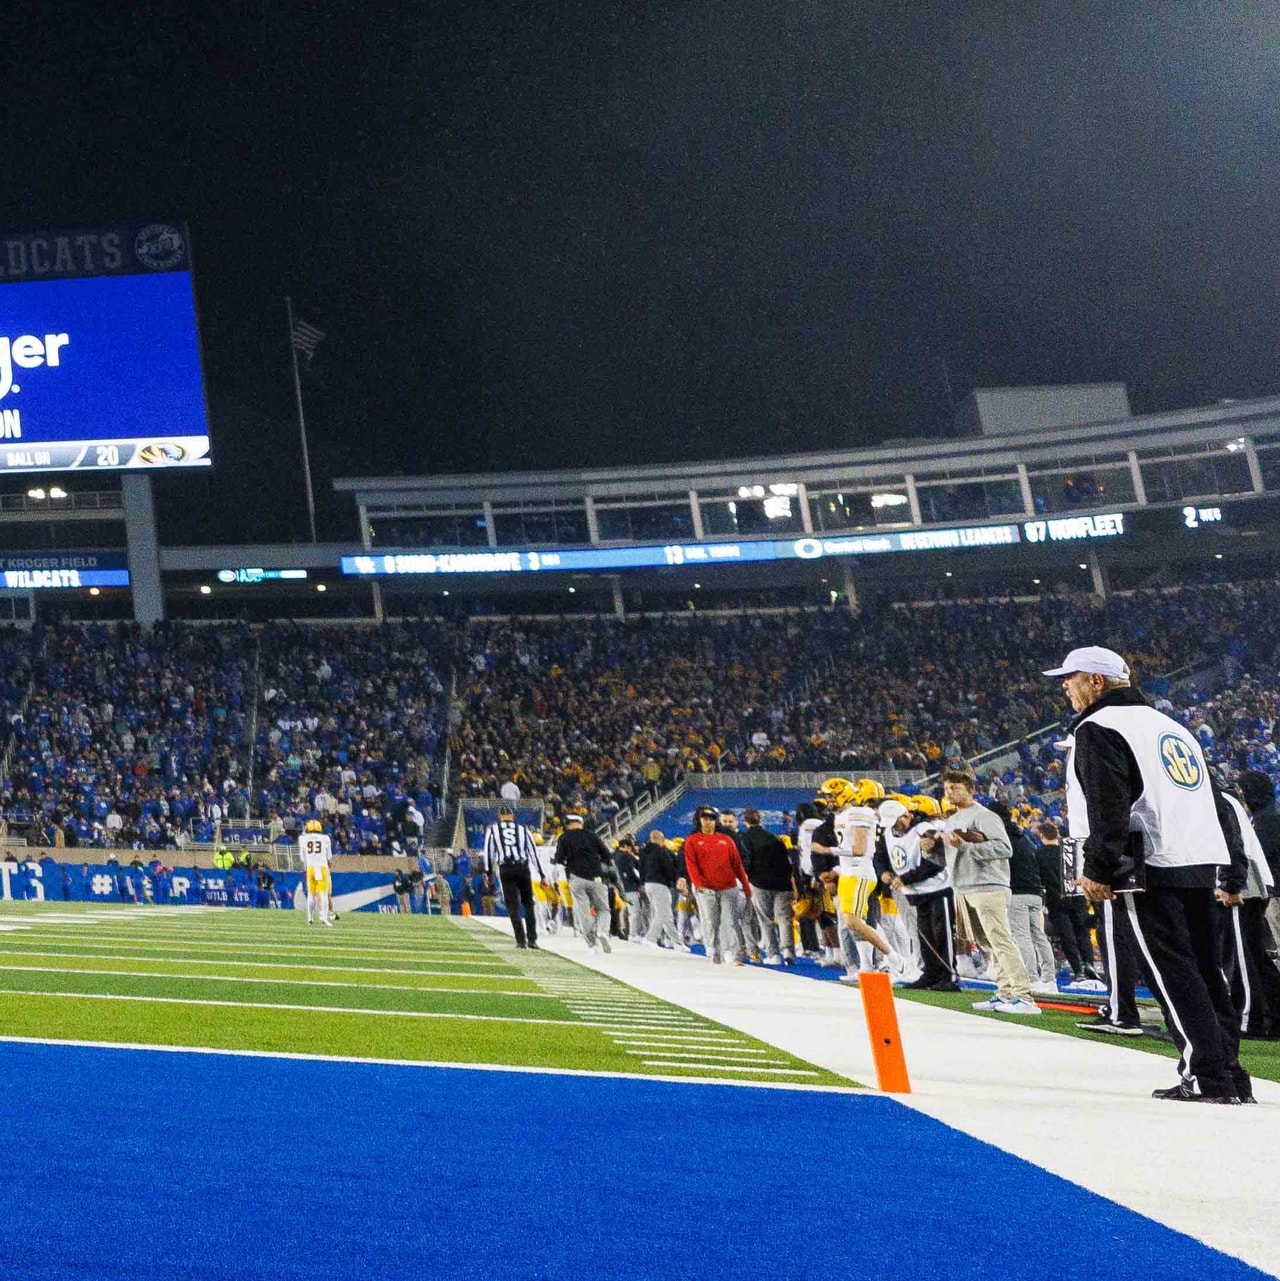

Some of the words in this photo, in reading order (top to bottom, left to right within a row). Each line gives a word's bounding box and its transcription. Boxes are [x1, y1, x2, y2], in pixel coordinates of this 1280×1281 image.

[96, 446, 119, 466] 20
[7, 558, 58, 568] KROGER
[61, 557, 97, 567] FIELD
[503, 828, 516, 846] S
[307, 841, 321, 854] 93
[205, 888, 249, 902] WILDATS
